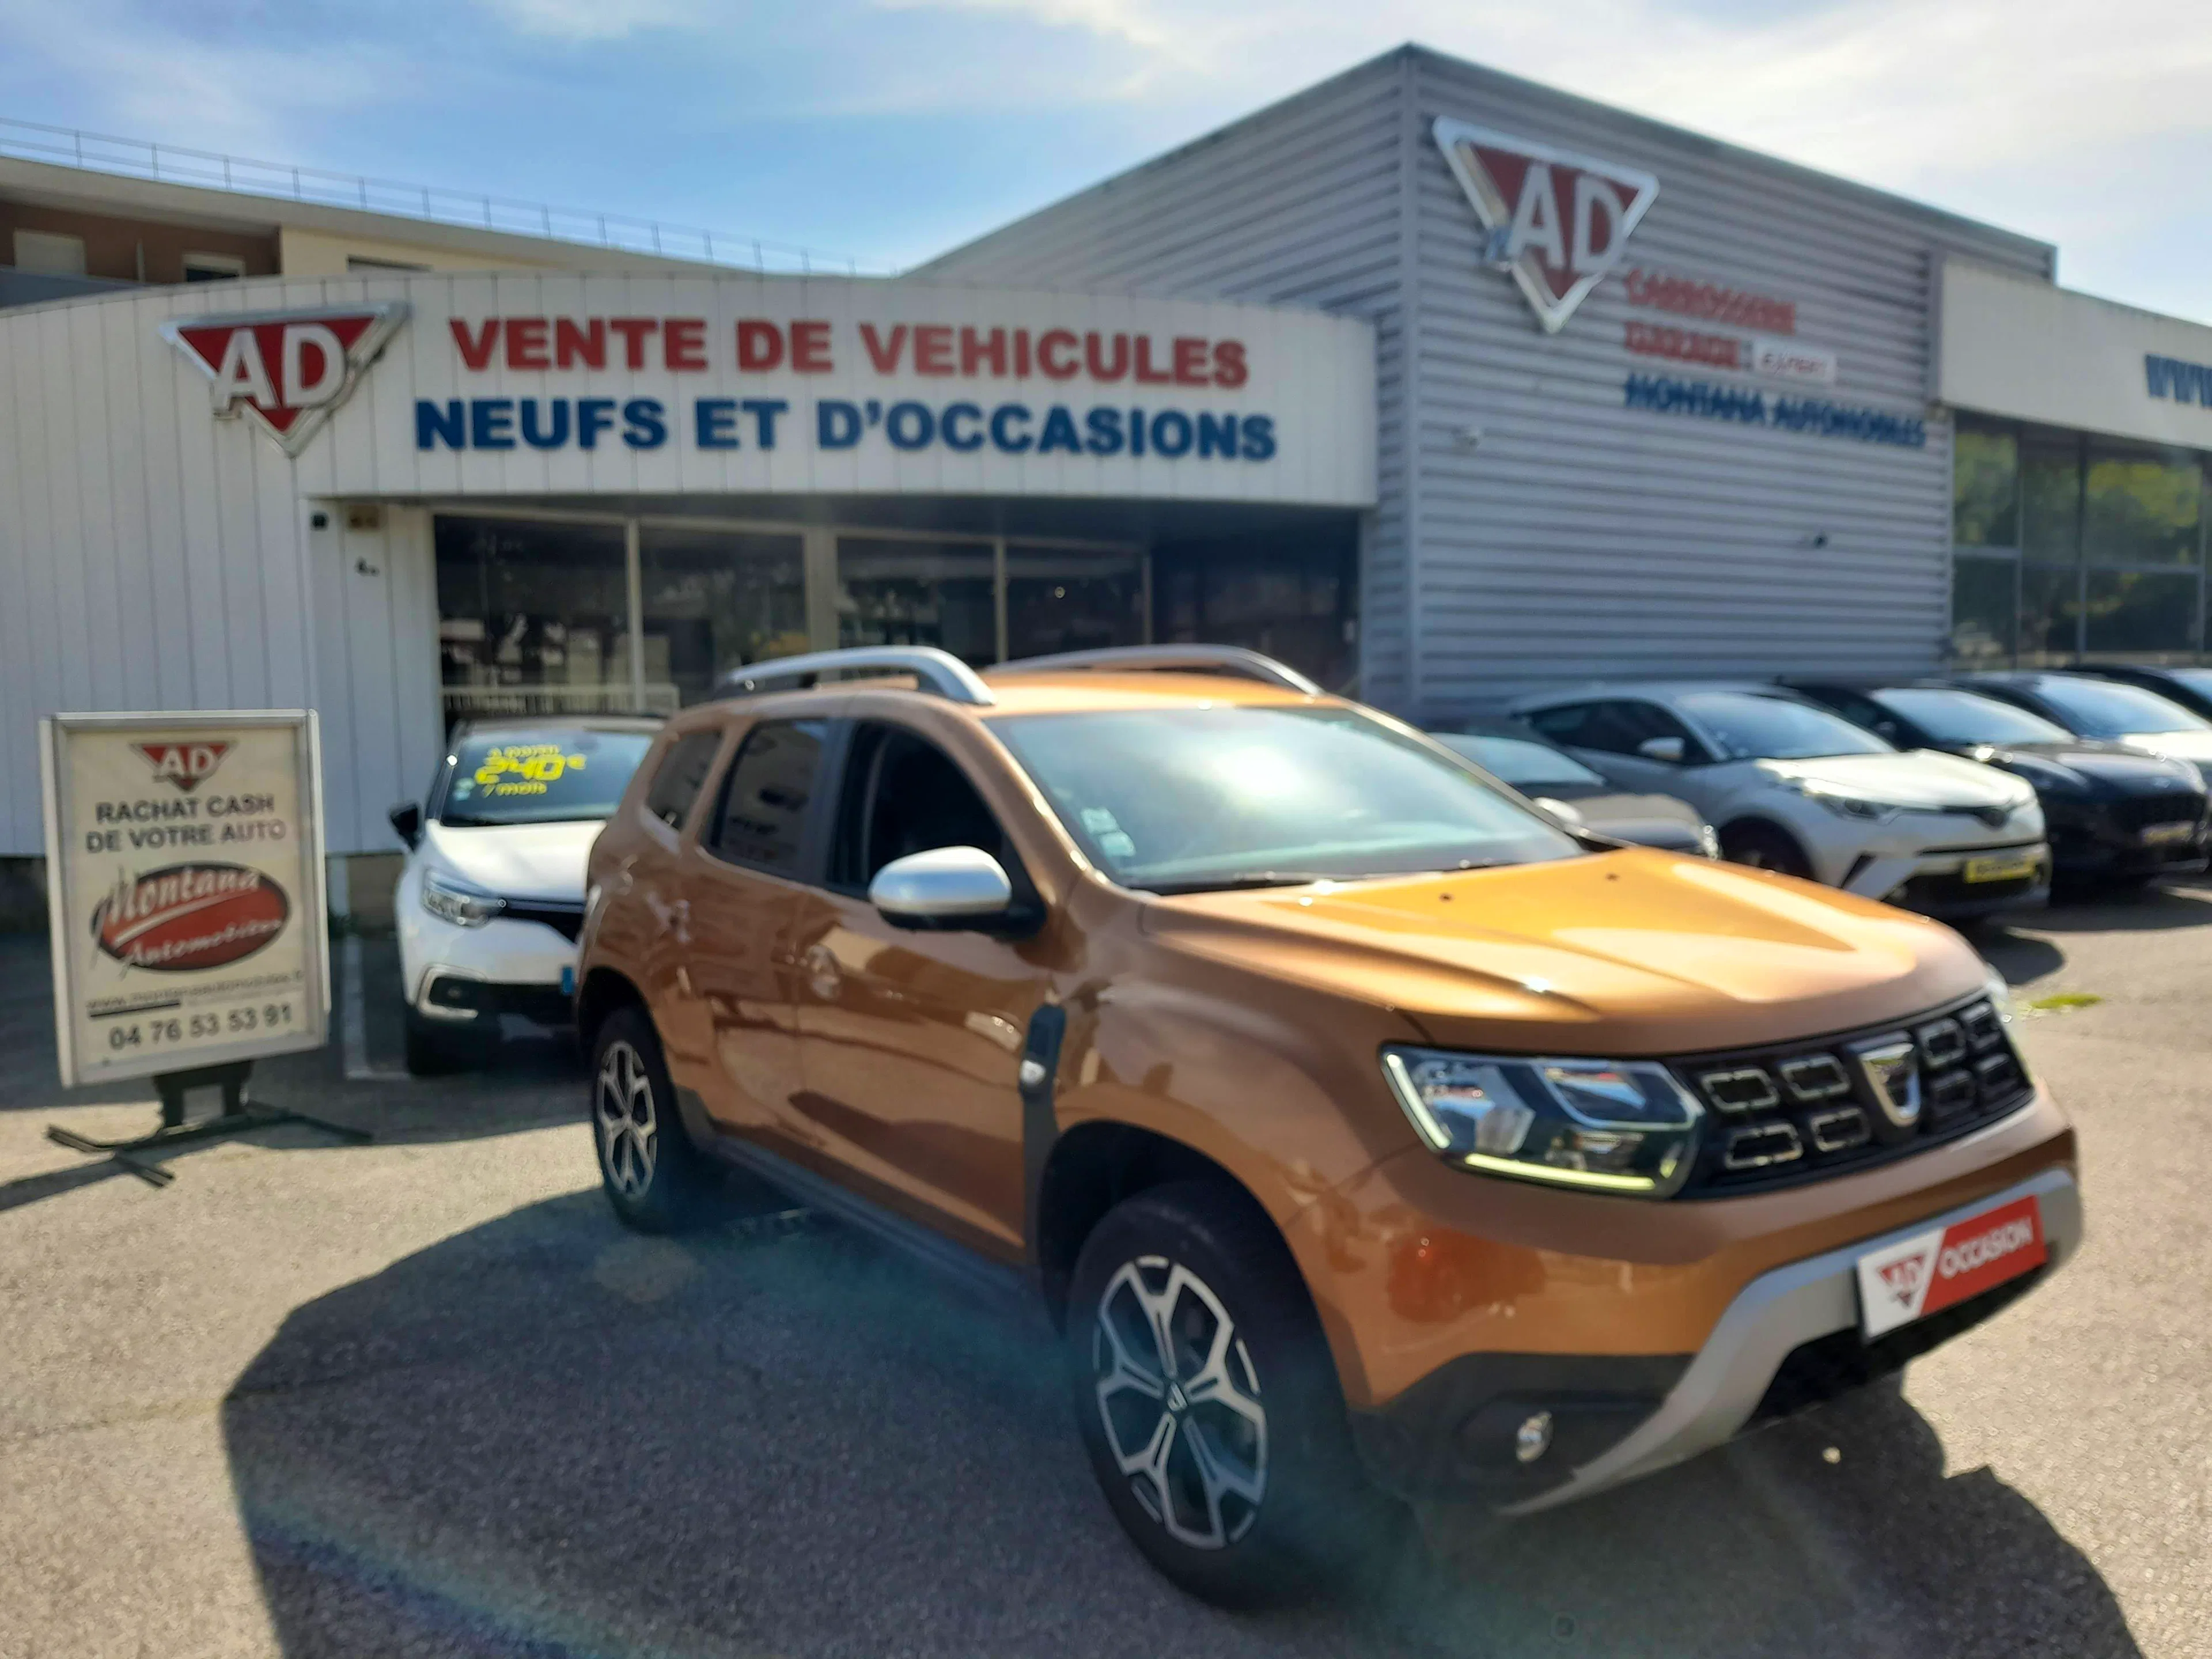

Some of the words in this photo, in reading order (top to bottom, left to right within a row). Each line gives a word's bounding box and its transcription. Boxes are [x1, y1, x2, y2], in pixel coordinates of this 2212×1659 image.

[1506, 161, 1626, 276] AD
[213, 321, 347, 416] AD
[450, 317, 709, 373] VENTE
[737, 319, 834, 374] DE
[859, 322, 1249, 389] VEHICULES
[414, 396, 668, 450] NEUFS
[696, 399, 789, 450] ET
[815, 397, 1279, 462] D'OCCASIONS
[157, 747, 220, 779] AD
[86, 829, 122, 854] DE
[128, 823, 216, 850] VOTRE
[220, 819, 286, 843] AUTO
[96, 797, 199, 823] RACHAT
[206, 793, 276, 817] CASH
[91, 865, 262, 968] Montana
[109, 1026, 142, 1050] 04
[150, 1018, 183, 1042] 76
[189, 1012, 220, 1037] 53
[227, 1006, 258, 1032] 53
[263, 1002, 292, 1027] 91
[1937, 1216, 2034, 1279] OCCASION
